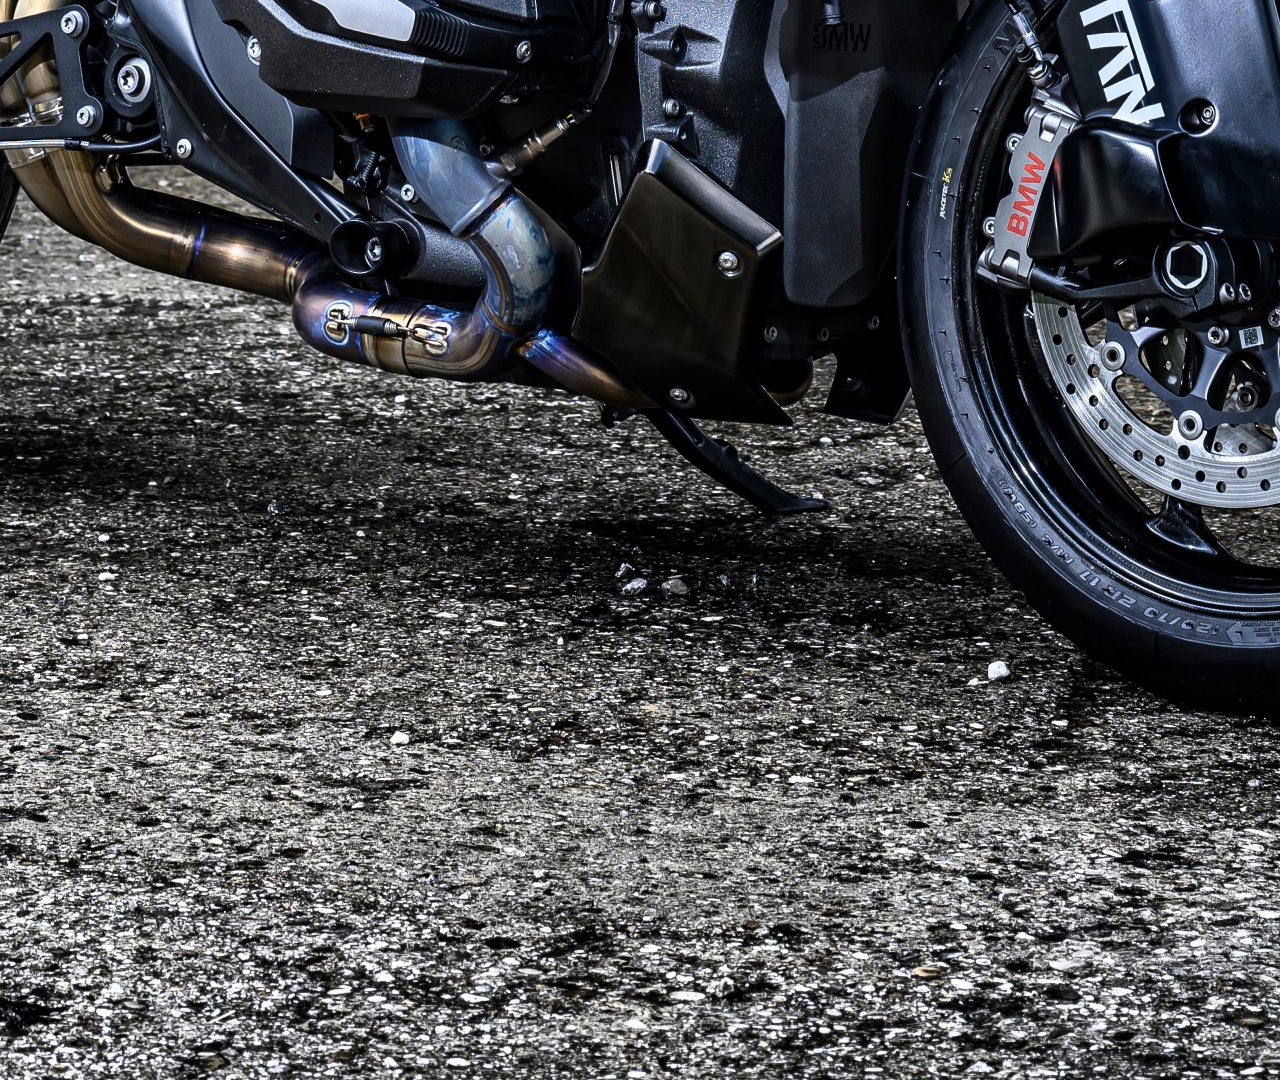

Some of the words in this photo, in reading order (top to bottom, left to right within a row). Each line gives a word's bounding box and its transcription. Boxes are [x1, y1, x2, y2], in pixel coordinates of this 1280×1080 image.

[812, 22, 872, 52] BMW
[1006, 151, 1047, 237] BMW
[1078, 571, 1102, 588] 17
